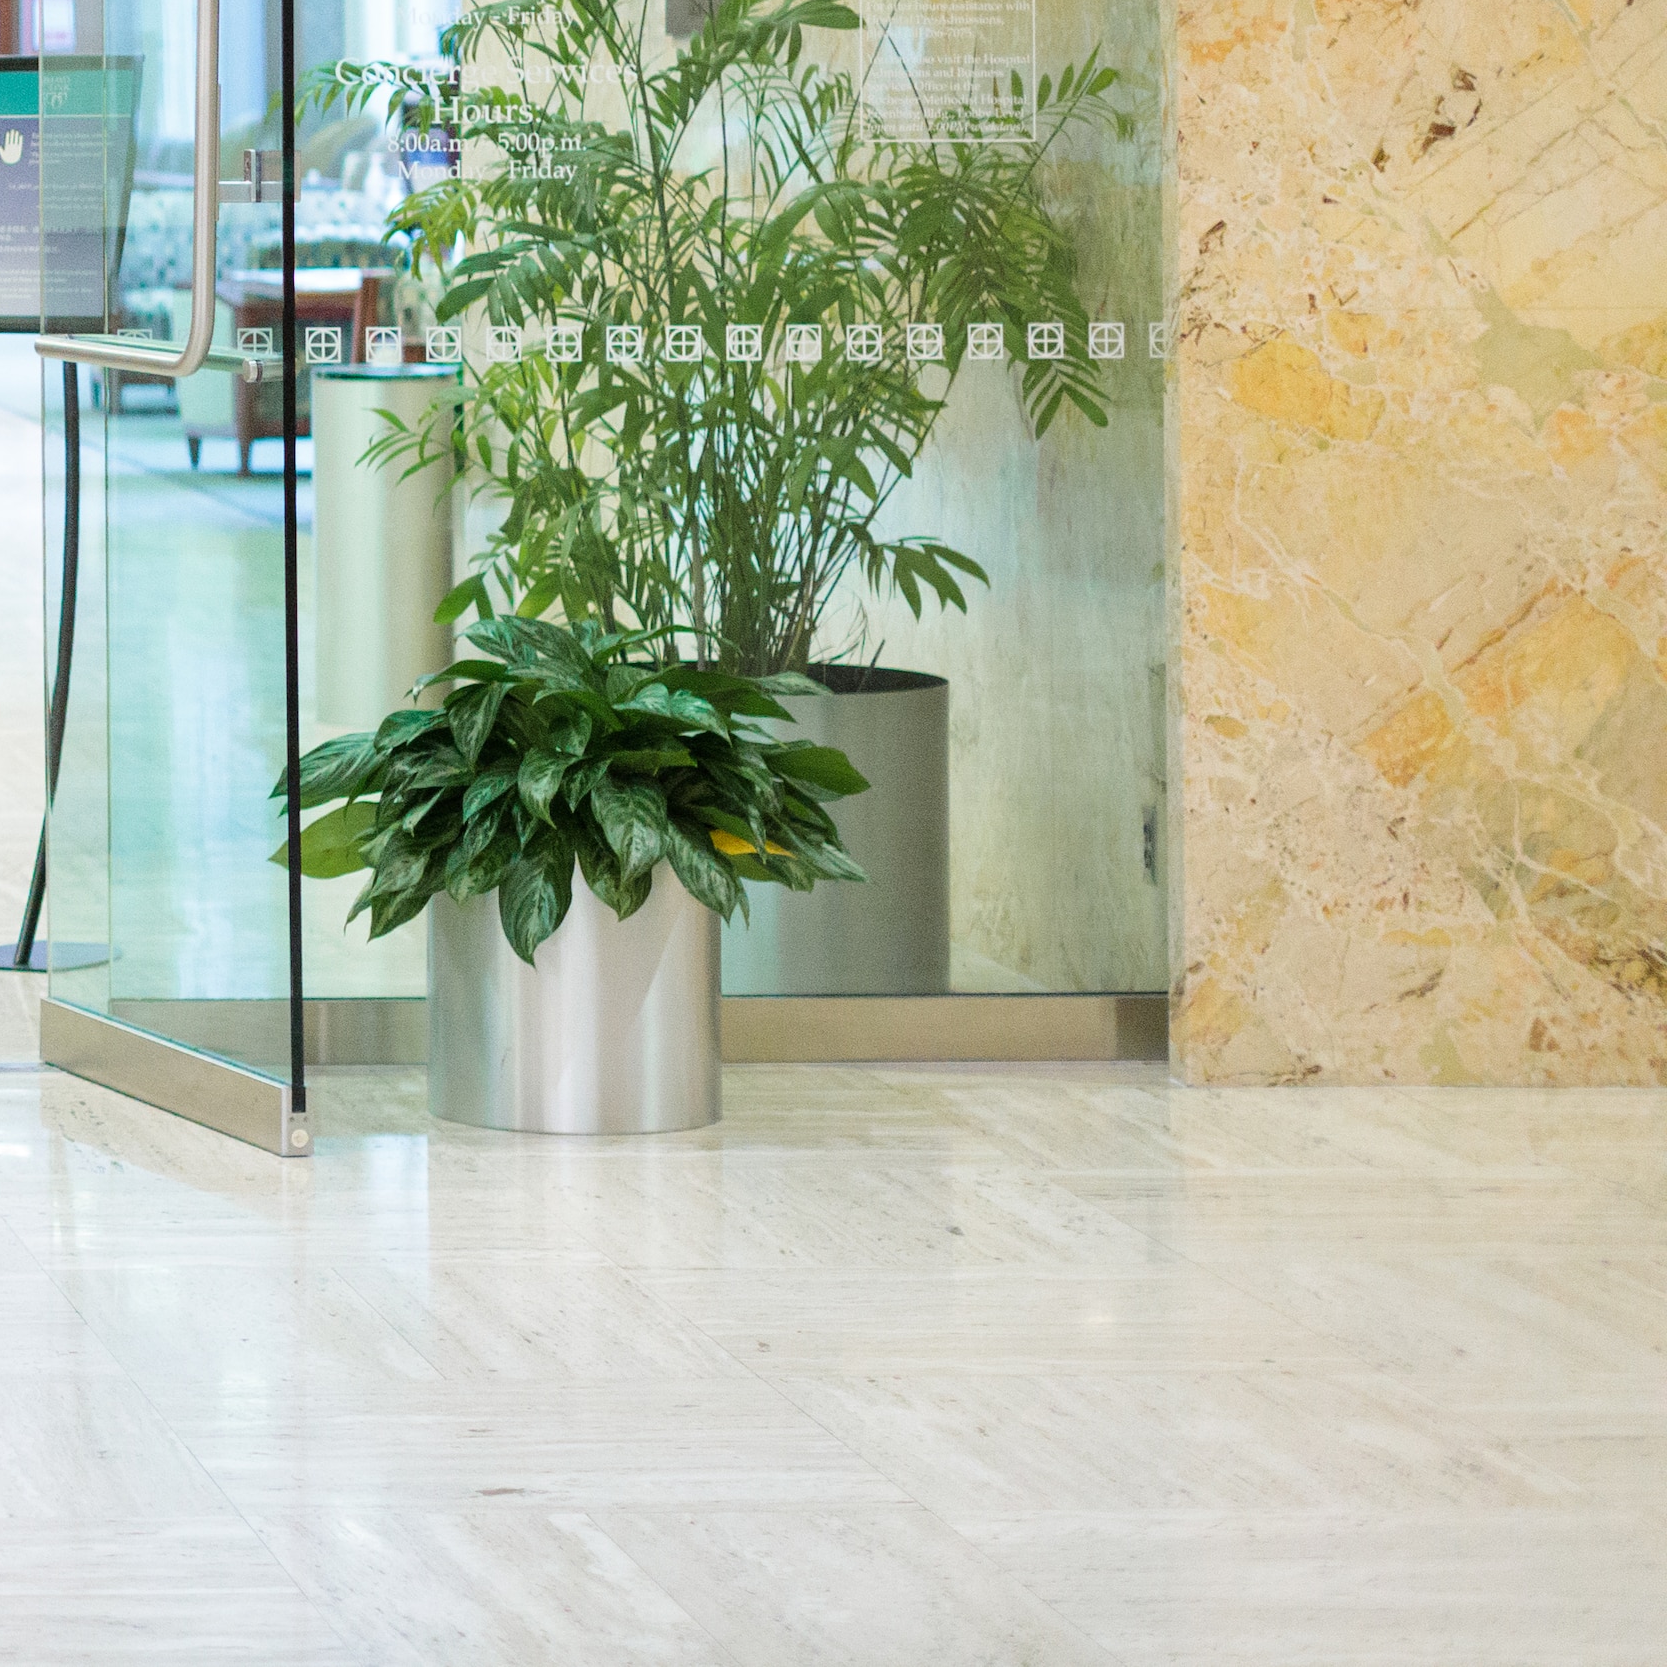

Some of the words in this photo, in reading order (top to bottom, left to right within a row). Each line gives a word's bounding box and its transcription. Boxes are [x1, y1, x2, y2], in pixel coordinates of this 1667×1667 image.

[507, 5, 576, 31] Friday
[1005, 0, 1030, 11] with
[933, 68, 954, 77] and
[983, 53, 1030, 67] Hospital
[335, 57, 498, 94] Concierge
[506, 56, 639, 85] Services
[432, 95, 543, 125] Hours:
[387, 132, 473, 153] 8:00a.m
[497, 132, 587, 157] 5:00p.m.
[398, 159, 486, 185] Monday
[508, 159, 579, 186] Friday
